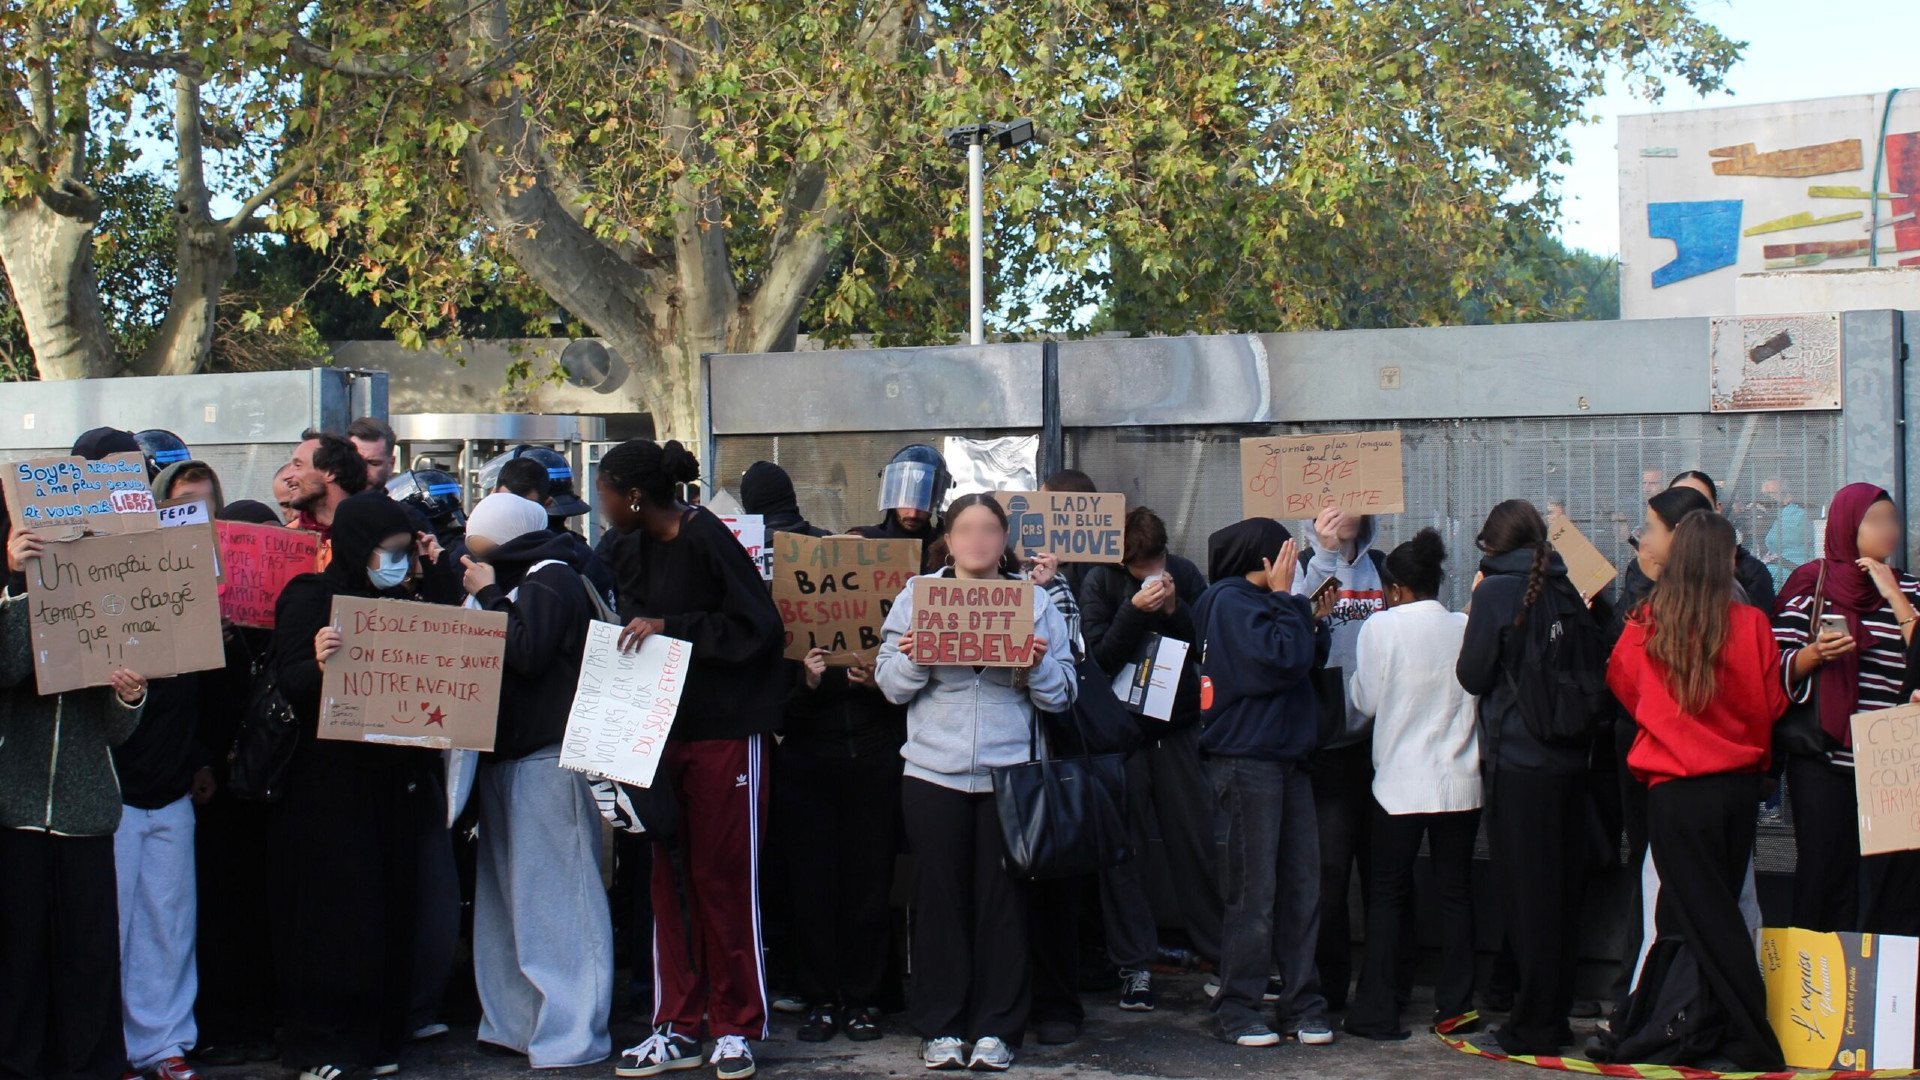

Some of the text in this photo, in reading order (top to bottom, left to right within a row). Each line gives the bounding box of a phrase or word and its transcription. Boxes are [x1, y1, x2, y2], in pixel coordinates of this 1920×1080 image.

[1259, 435, 1393, 457] Journées plus longues
[1306, 450, 1342, 466] que la
[18, 461, 82, 486] Soyez
[72, 481, 101, 495] plus
[1051, 496, 1101, 513] LADY
[1286, 490, 1382, 512] BRIGITTE
[1022, 524, 1043, 535] CRS
[1053, 513, 1112, 526] IN BLUE
[857, 543, 892, 566] LE
[1050, 530, 1121, 555] MOVE
[39, 552, 82, 591] Un
[158, 550, 195, 572] du
[794, 570, 860, 595] BAC
[35, 600, 96, 627] temps
[130, 582, 196, 616] chargé
[929, 586, 1022, 607] MACRON
[354, 608, 418, 635] DÉSOLÉ
[918, 609, 1016, 630] PAS DTT
[78, 616, 161, 653] que moi
[809, 631, 847, 651] LA
[916, 631, 1035, 663] BEBEW
[349, 646, 374, 662] ON
[435, 655, 456, 668] DE
[460, 655, 500, 671] SAUVER
[343, 671, 481, 703] NOTRE AVENIR
[565, 624, 611, 760] VOUS PRENEZ PAS LES
[590, 651, 636, 764] VIOLEURS CAR VOU
[622, 682, 653, 743] AVEZ PEUR
[643, 697, 672, 736] SOUS
[1868, 714, 1920, 744] C'EST
[632, 736, 656, 757] DU
[1790, 950, 1825, 1041] L'exquise
